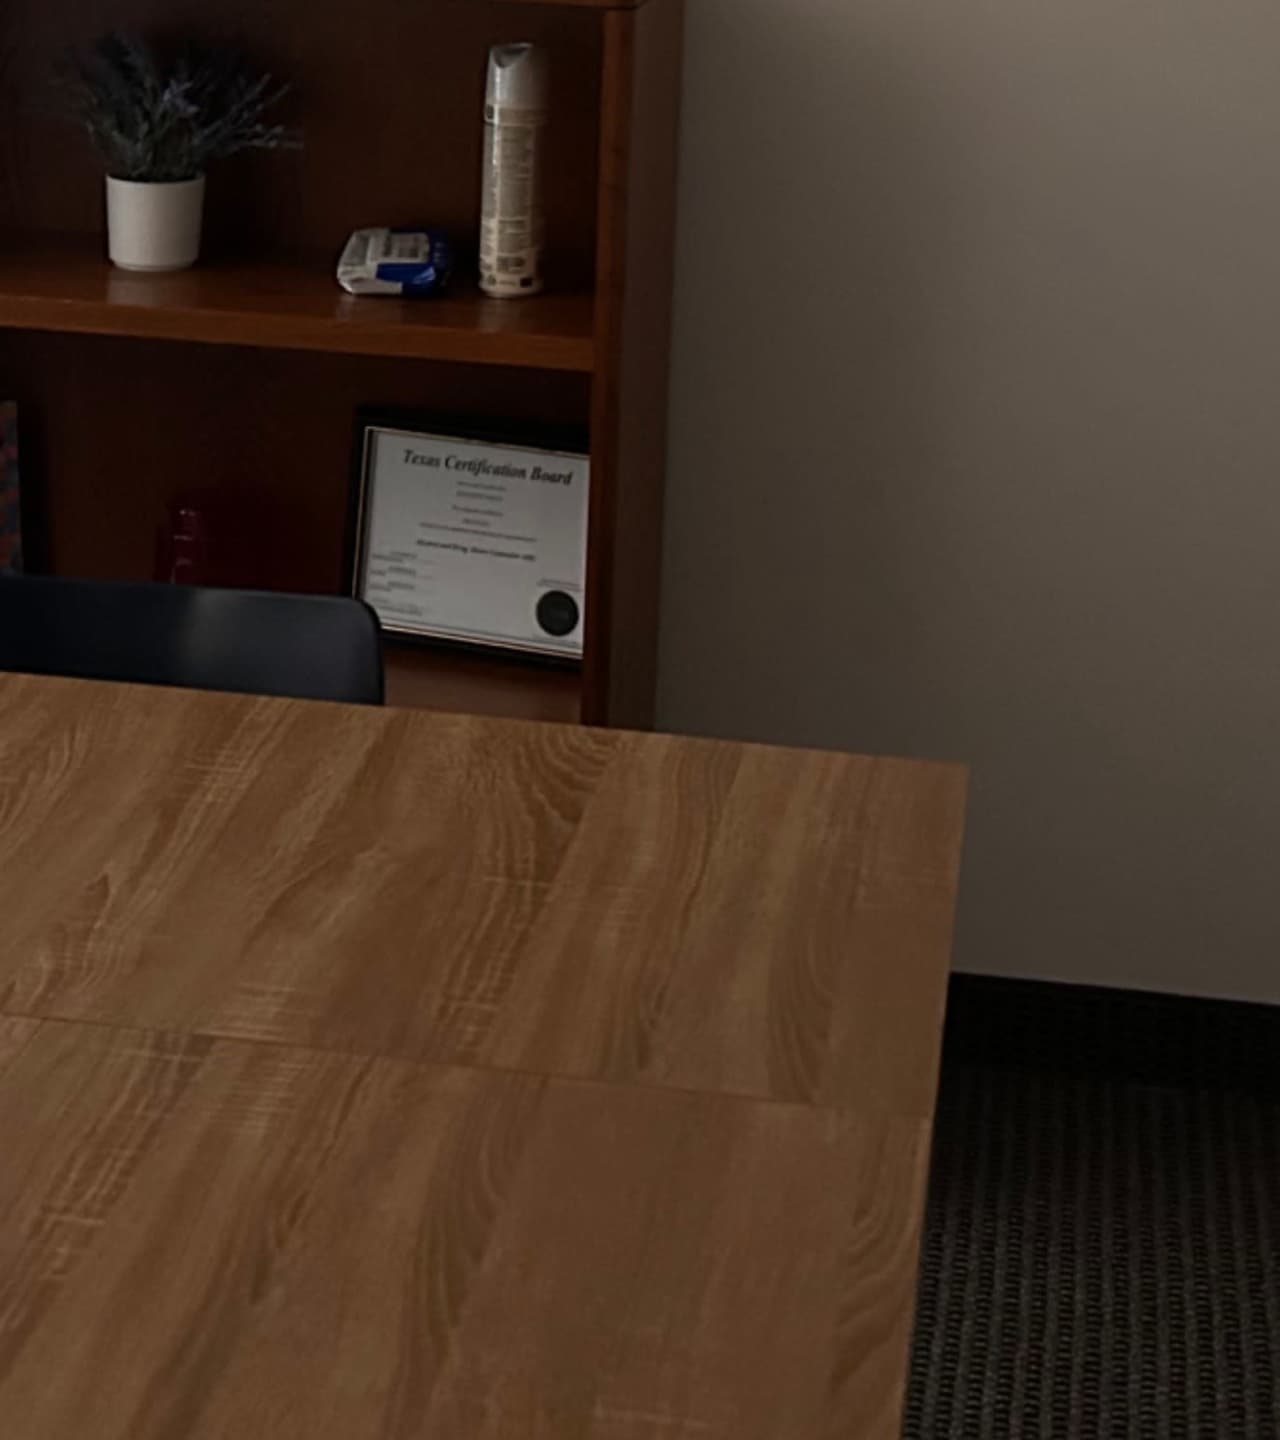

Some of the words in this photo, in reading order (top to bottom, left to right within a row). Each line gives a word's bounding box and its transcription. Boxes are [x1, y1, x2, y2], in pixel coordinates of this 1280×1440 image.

[403, 449, 441, 469] Texas
[444, 454, 527, 480] Certification
[530, 466, 574, 485] Board
